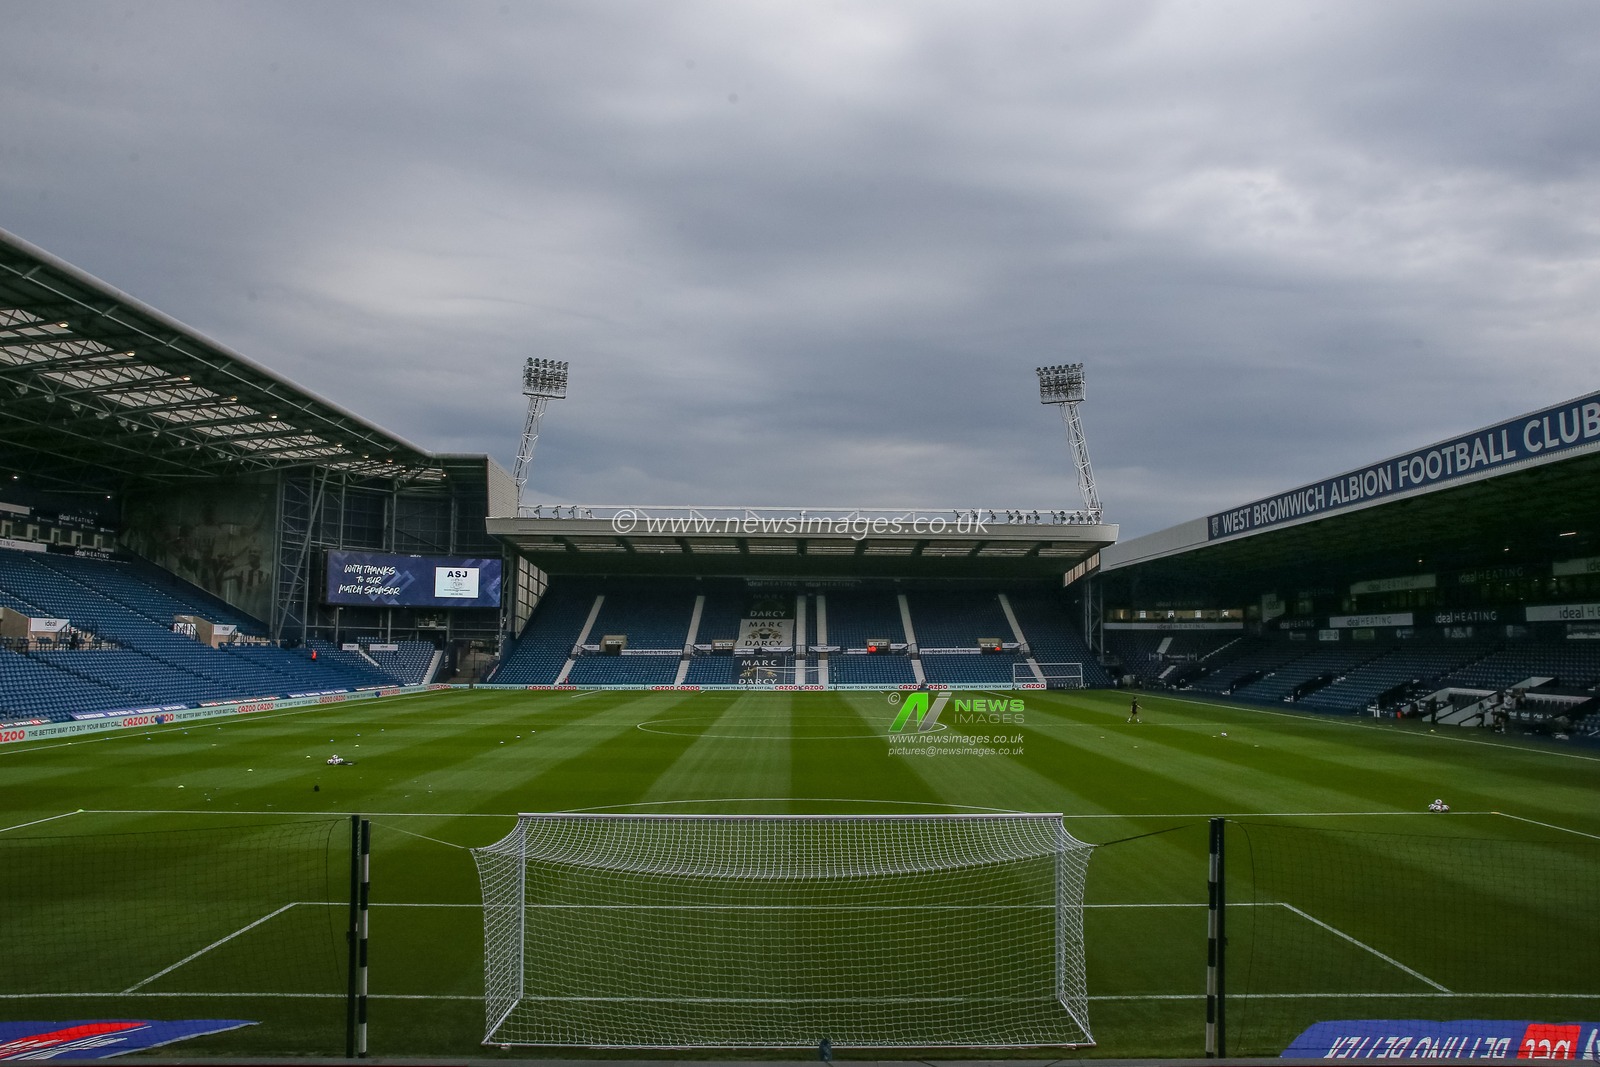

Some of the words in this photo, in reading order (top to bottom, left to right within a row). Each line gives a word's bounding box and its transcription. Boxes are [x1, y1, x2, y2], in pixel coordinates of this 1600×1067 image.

[1222, 512, 1250, 534] WEST
[1254, 486, 1325, 526] BROMWICH
[1330, 465, 1392, 507] ALBION
[1398, 430, 1516, 488] FOOTBALL
[1523, 402, 1600, 452] CLUB
[86, 551, 110, 559] HEATING
[344, 564, 363, 574] WITH
[364, 566, 396, 576] THANKS
[1478, 566, 1524, 580] HEATING
[338, 584, 363, 594] MATCH
[364, 586, 400, 596] SPONSOR
[1454, 611, 1496, 622] HEATING
[1560, 606, 1584, 618] ideal
[1360, 616, 1392, 624] HEATING
[238, 704, 256, 713] CAZOO
[257, 702, 274, 710] CAZOO
[123, 716, 148, 726] CAZOO
[39, 728, 56, 736] BETTER
